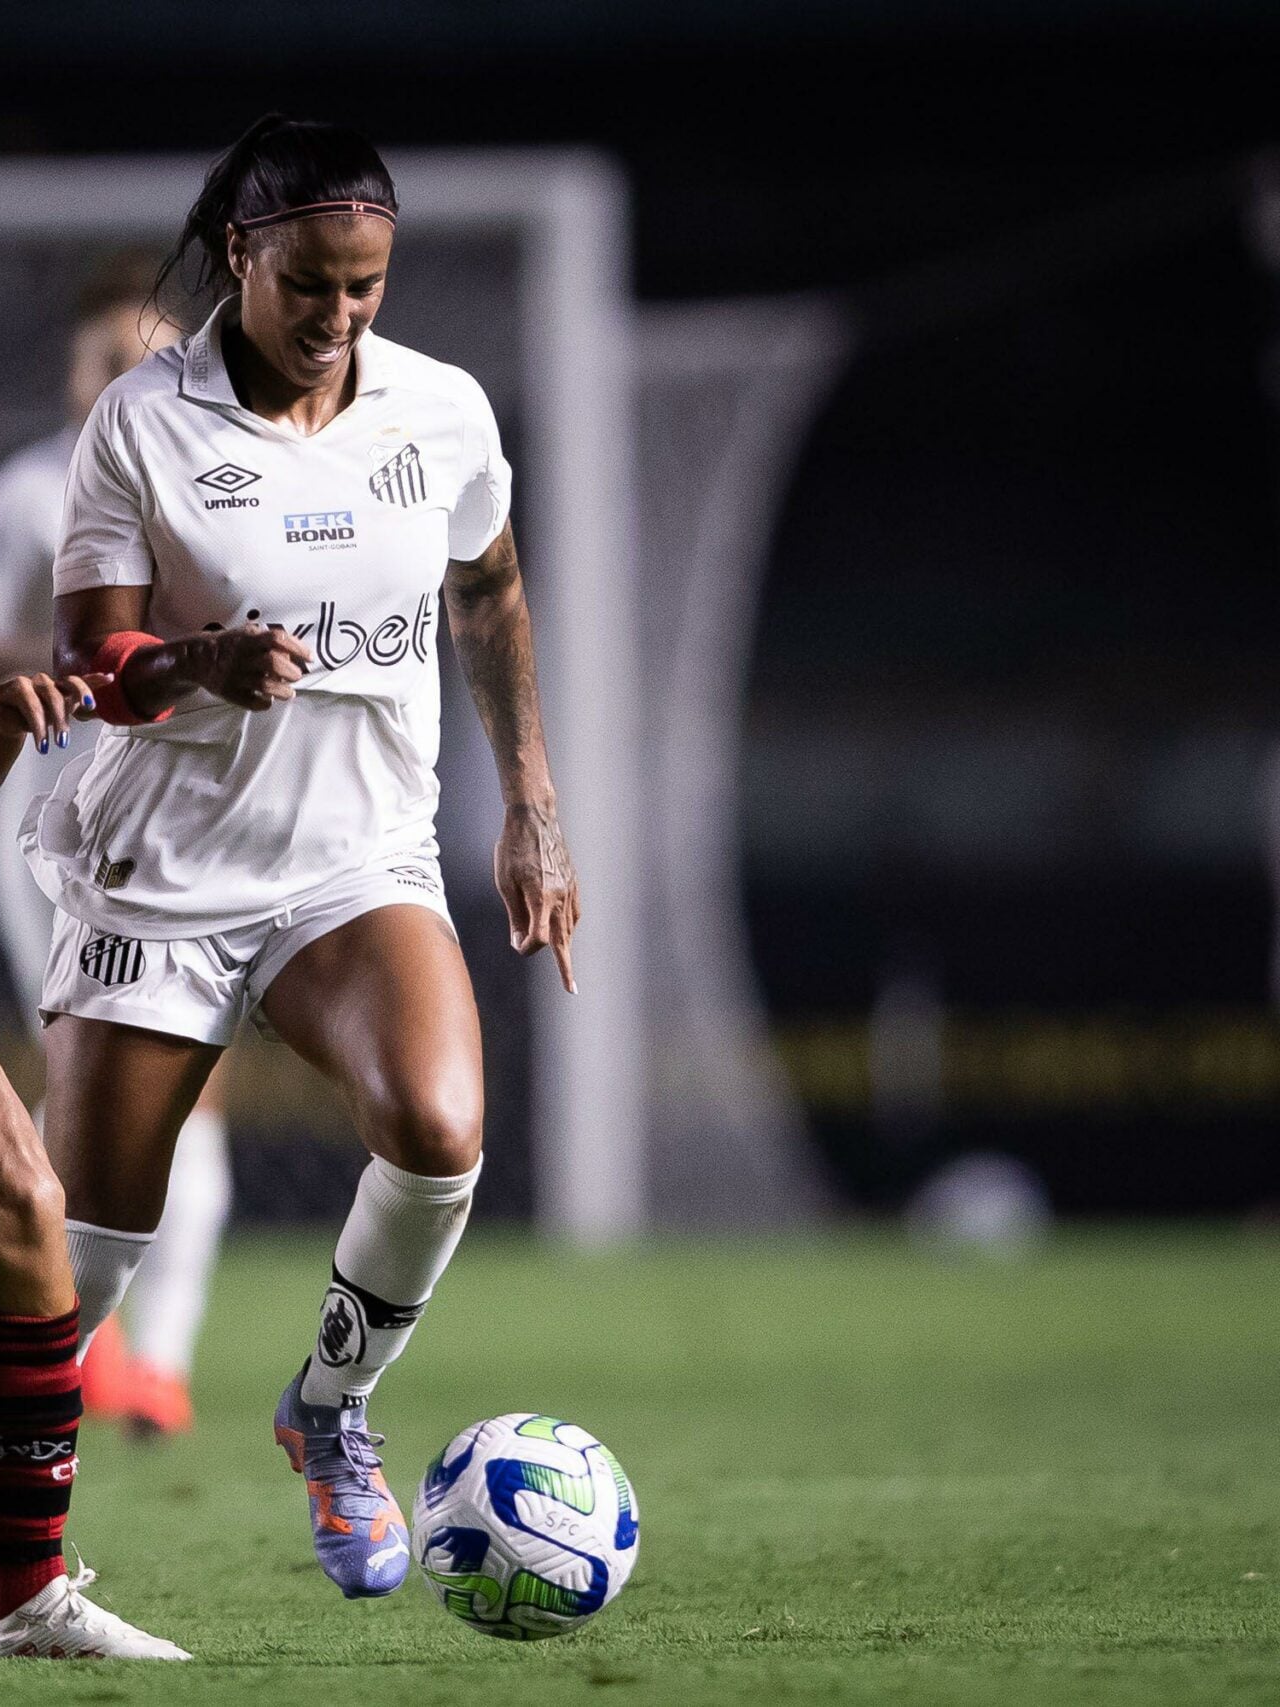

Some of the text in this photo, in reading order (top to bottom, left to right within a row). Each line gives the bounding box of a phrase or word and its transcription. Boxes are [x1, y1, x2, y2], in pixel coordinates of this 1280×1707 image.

[204, 495, 260, 510] umbro
[286, 513, 353, 528] TEK
[285, 527, 355, 543] BOND
